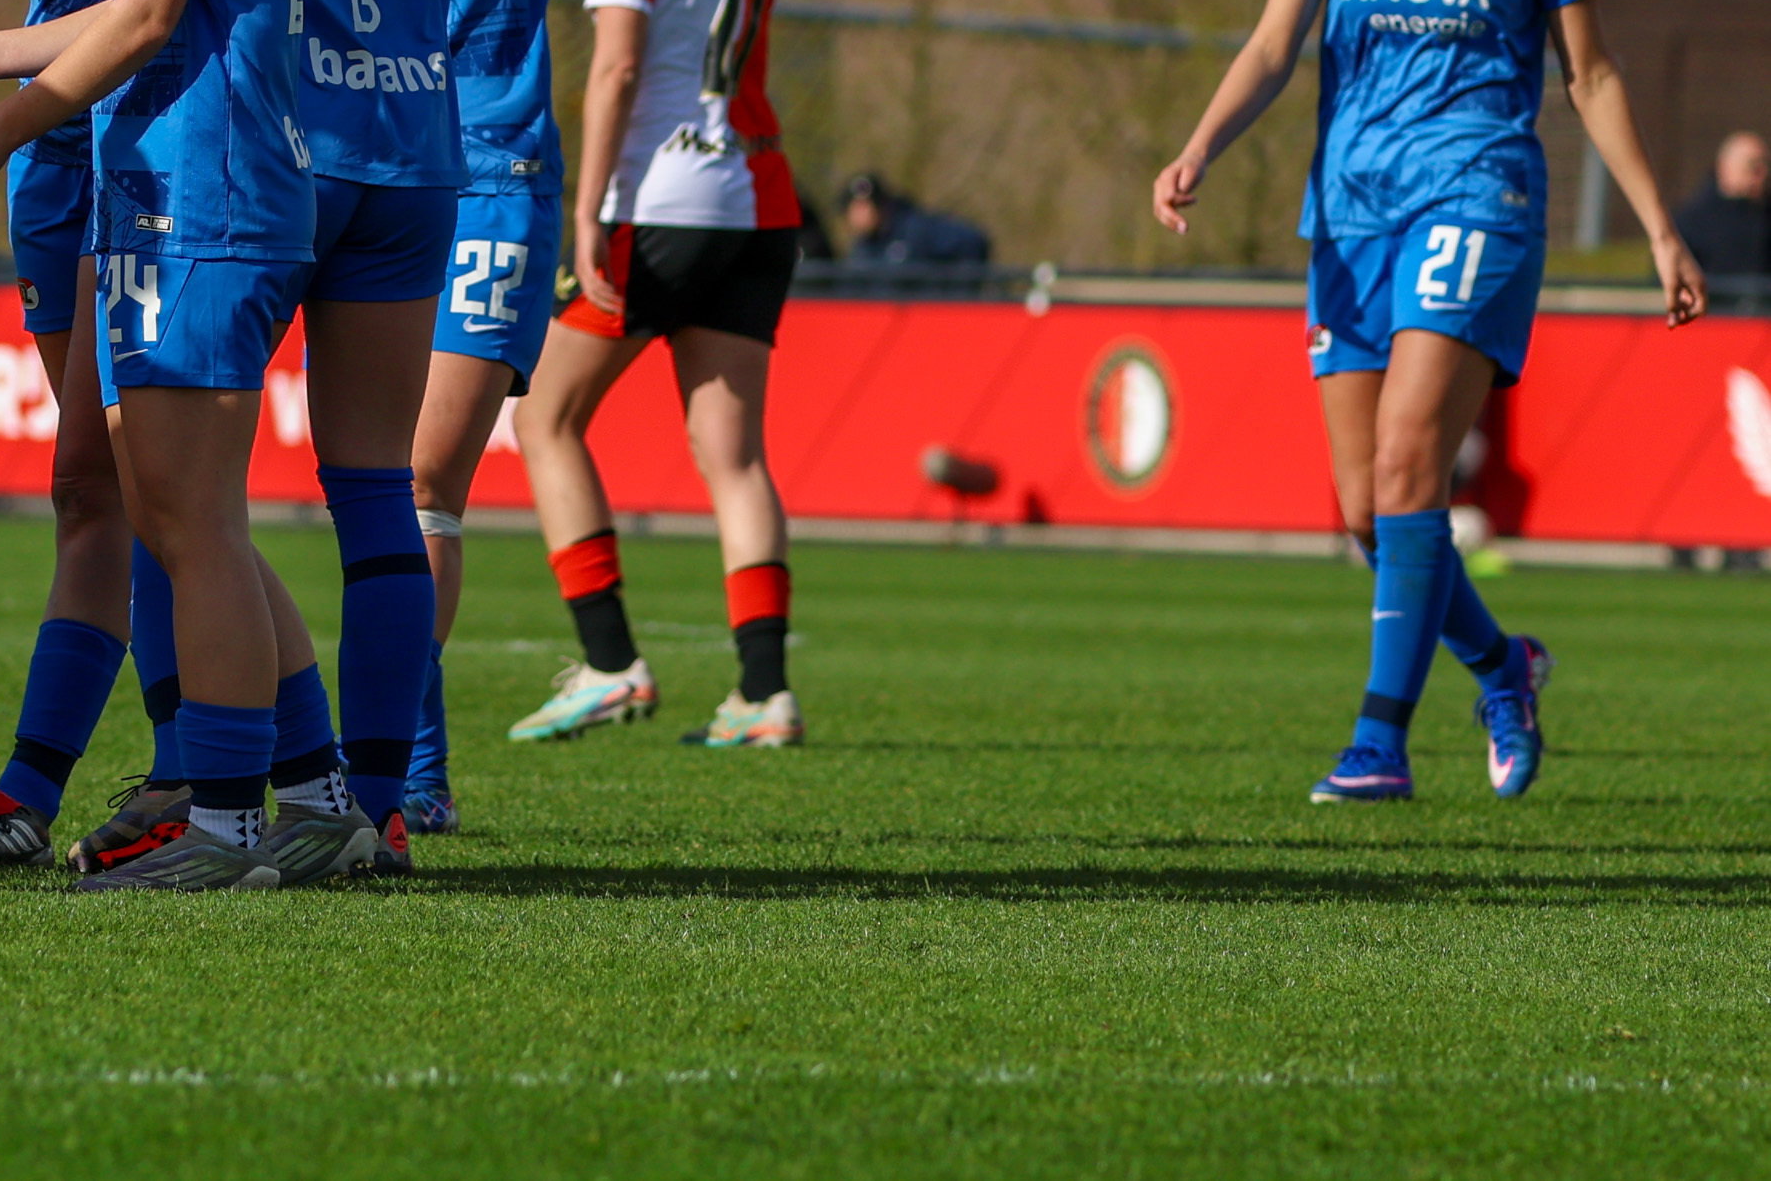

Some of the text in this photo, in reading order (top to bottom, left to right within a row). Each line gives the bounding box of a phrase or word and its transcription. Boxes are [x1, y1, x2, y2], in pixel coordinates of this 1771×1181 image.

[104, 254, 161, 343] 24
[450, 239, 529, 323] 22
[1415, 225, 1487, 303] 21
